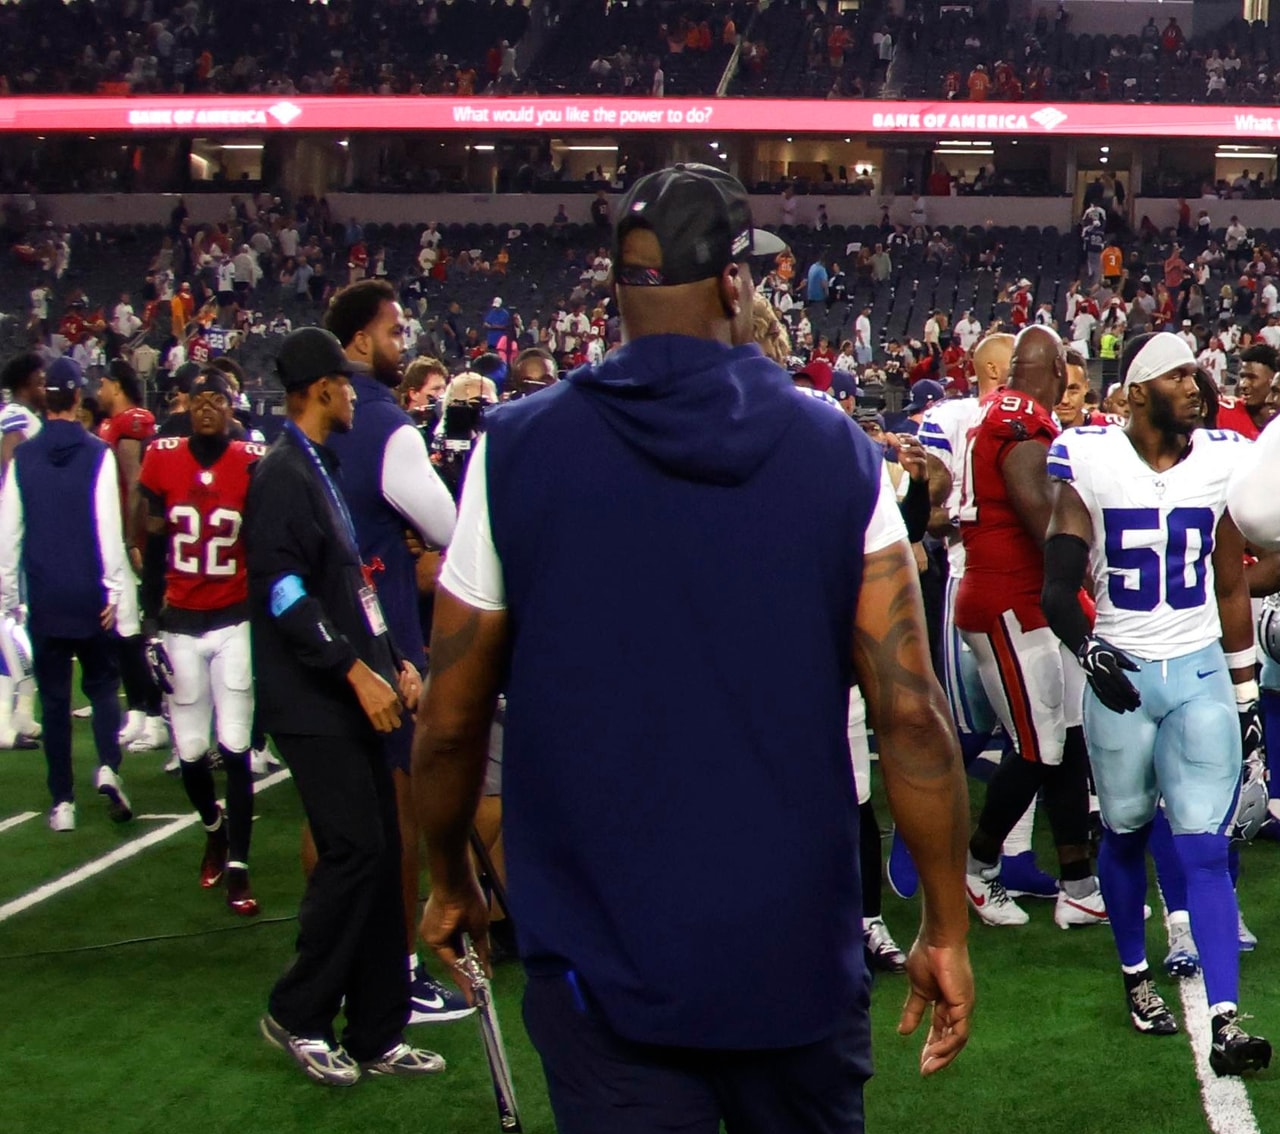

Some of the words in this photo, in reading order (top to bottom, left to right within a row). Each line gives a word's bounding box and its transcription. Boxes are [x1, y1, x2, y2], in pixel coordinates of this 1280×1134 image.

[453, 106, 488, 122] What
[493, 106, 533, 122] would
[536, 109, 562, 126] you
[566, 106, 589, 122] like
[594, 107, 616, 122] the
[620, 109, 663, 126] power
[667, 109, 682, 122] to
[686, 107, 712, 122] do?
[872, 113, 921, 128] BANK
[923, 114, 947, 128] OF
[949, 115, 1028, 129] AMERICA
[1234, 115, 1272, 131] What
[1000, 396, 1034, 415] 91
[170, 505, 243, 576] 22
[1102, 507, 1215, 612] 50
